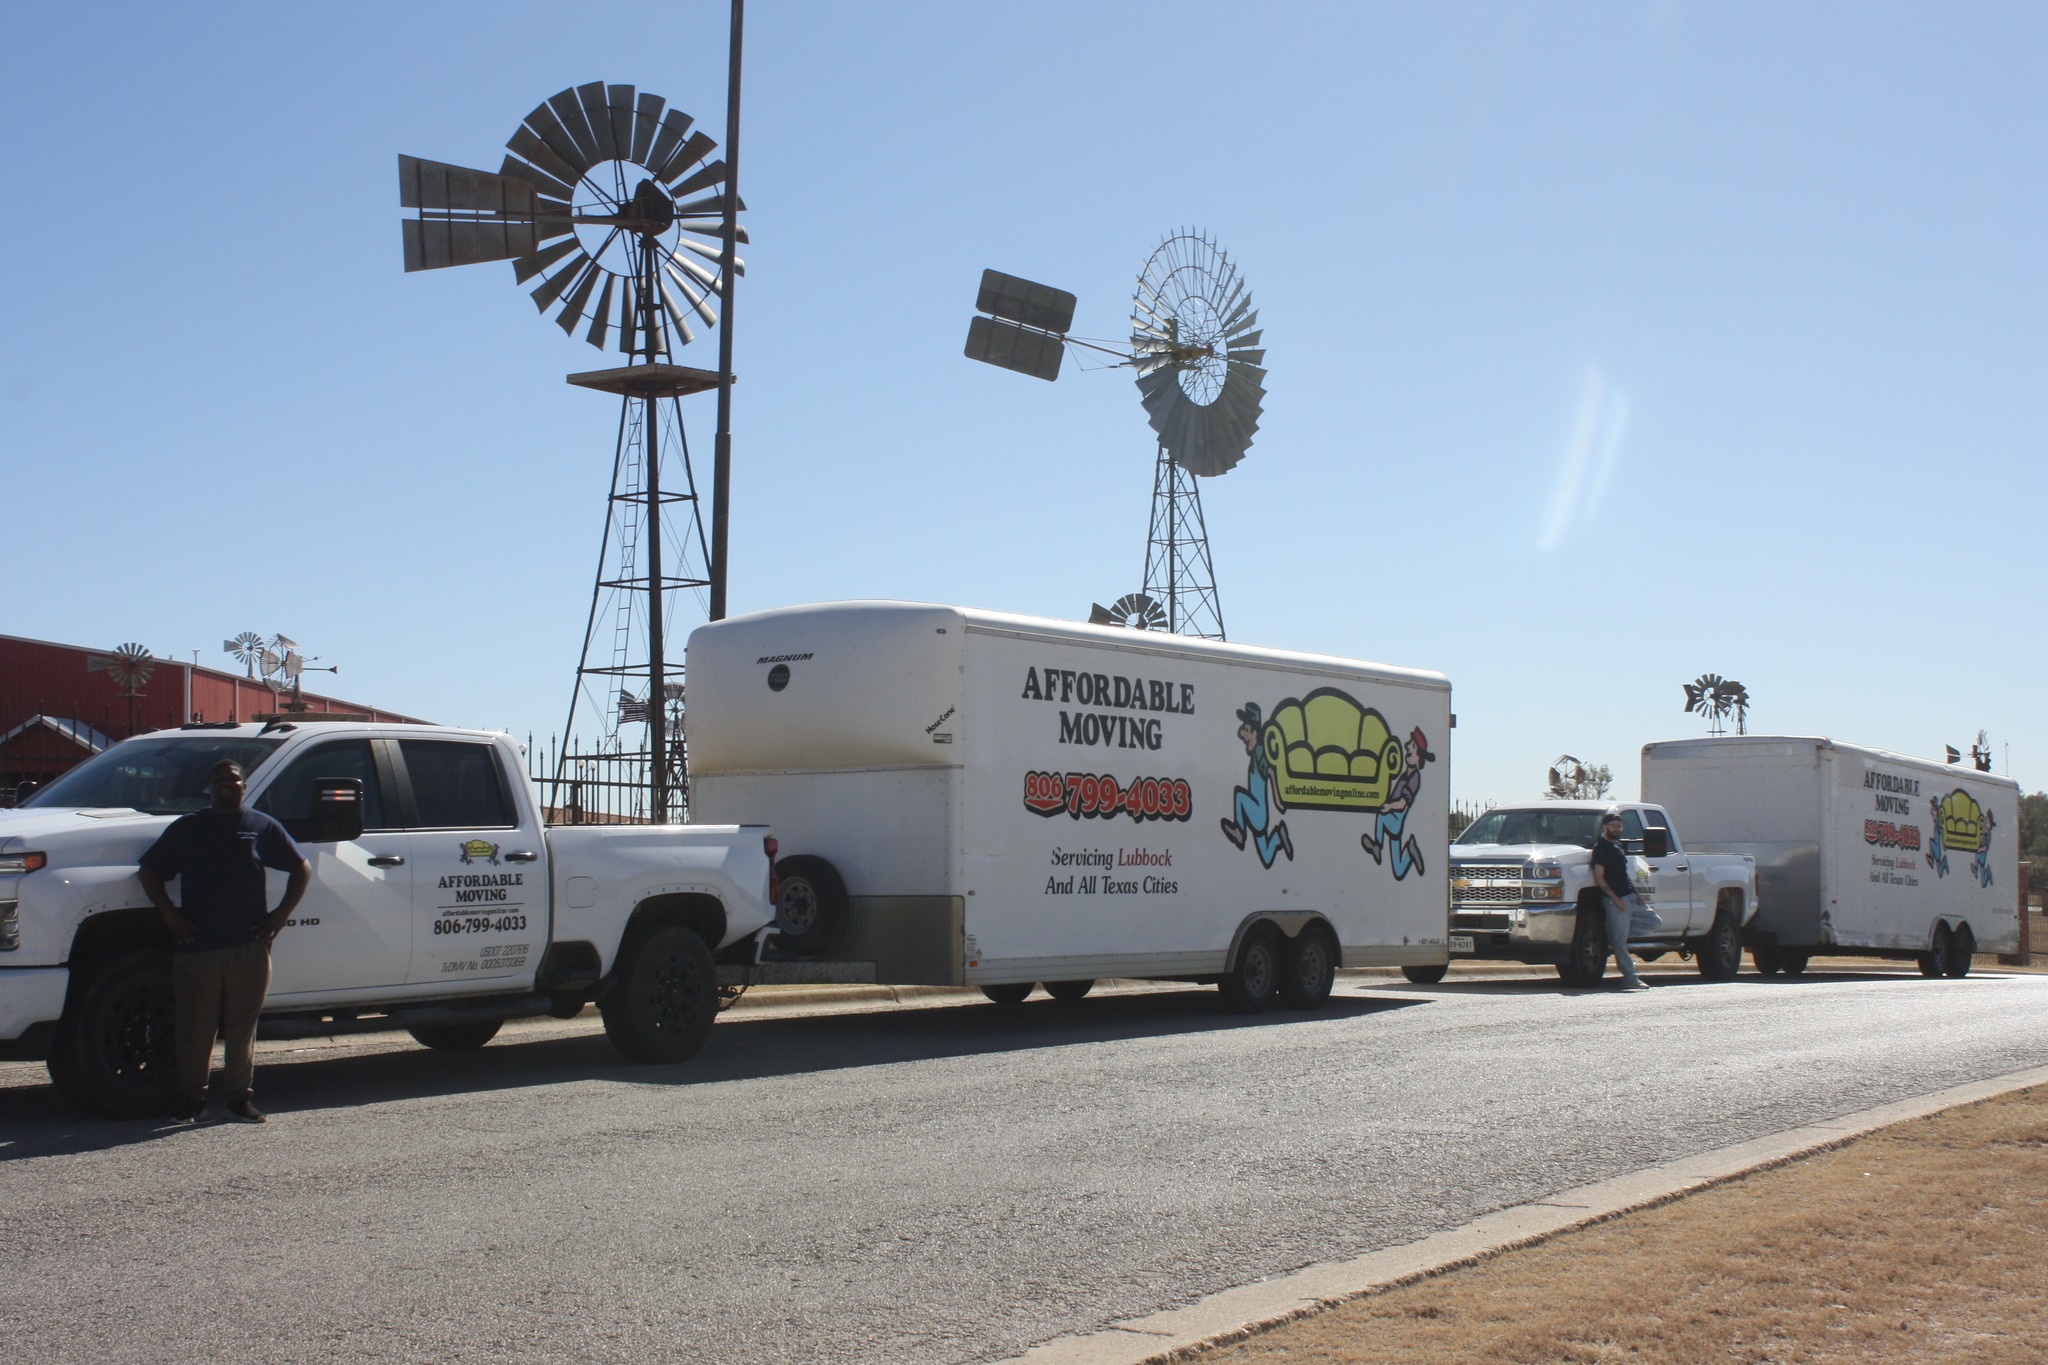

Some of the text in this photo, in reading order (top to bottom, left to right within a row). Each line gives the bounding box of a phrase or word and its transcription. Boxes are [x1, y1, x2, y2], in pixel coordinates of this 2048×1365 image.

[757, 653, 814, 665] MAGNUM
[1021, 666, 1195, 715] AFFORDABLE
[1059, 711, 1163, 751] MOVING
[1285, 784, 1380, 800] affordablemovingonline.com
[1863, 770, 1920, 797] AFFORDABLE
[1024, 770, 1192, 824] 806 799-4033
[1875, 794, 1910, 816] MOVING
[1051, 846, 1173, 871] Servicing Lubbock
[438, 873, 524, 888] AFFORDABLE
[1044, 875, 1178, 895] And All Texas Cities
[455, 889, 507, 902] MOVING
[300, 918, 320, 926] HD
[434, 915, 527, 935] 806-799-4033
[480, 945, 502, 958] USDOT
